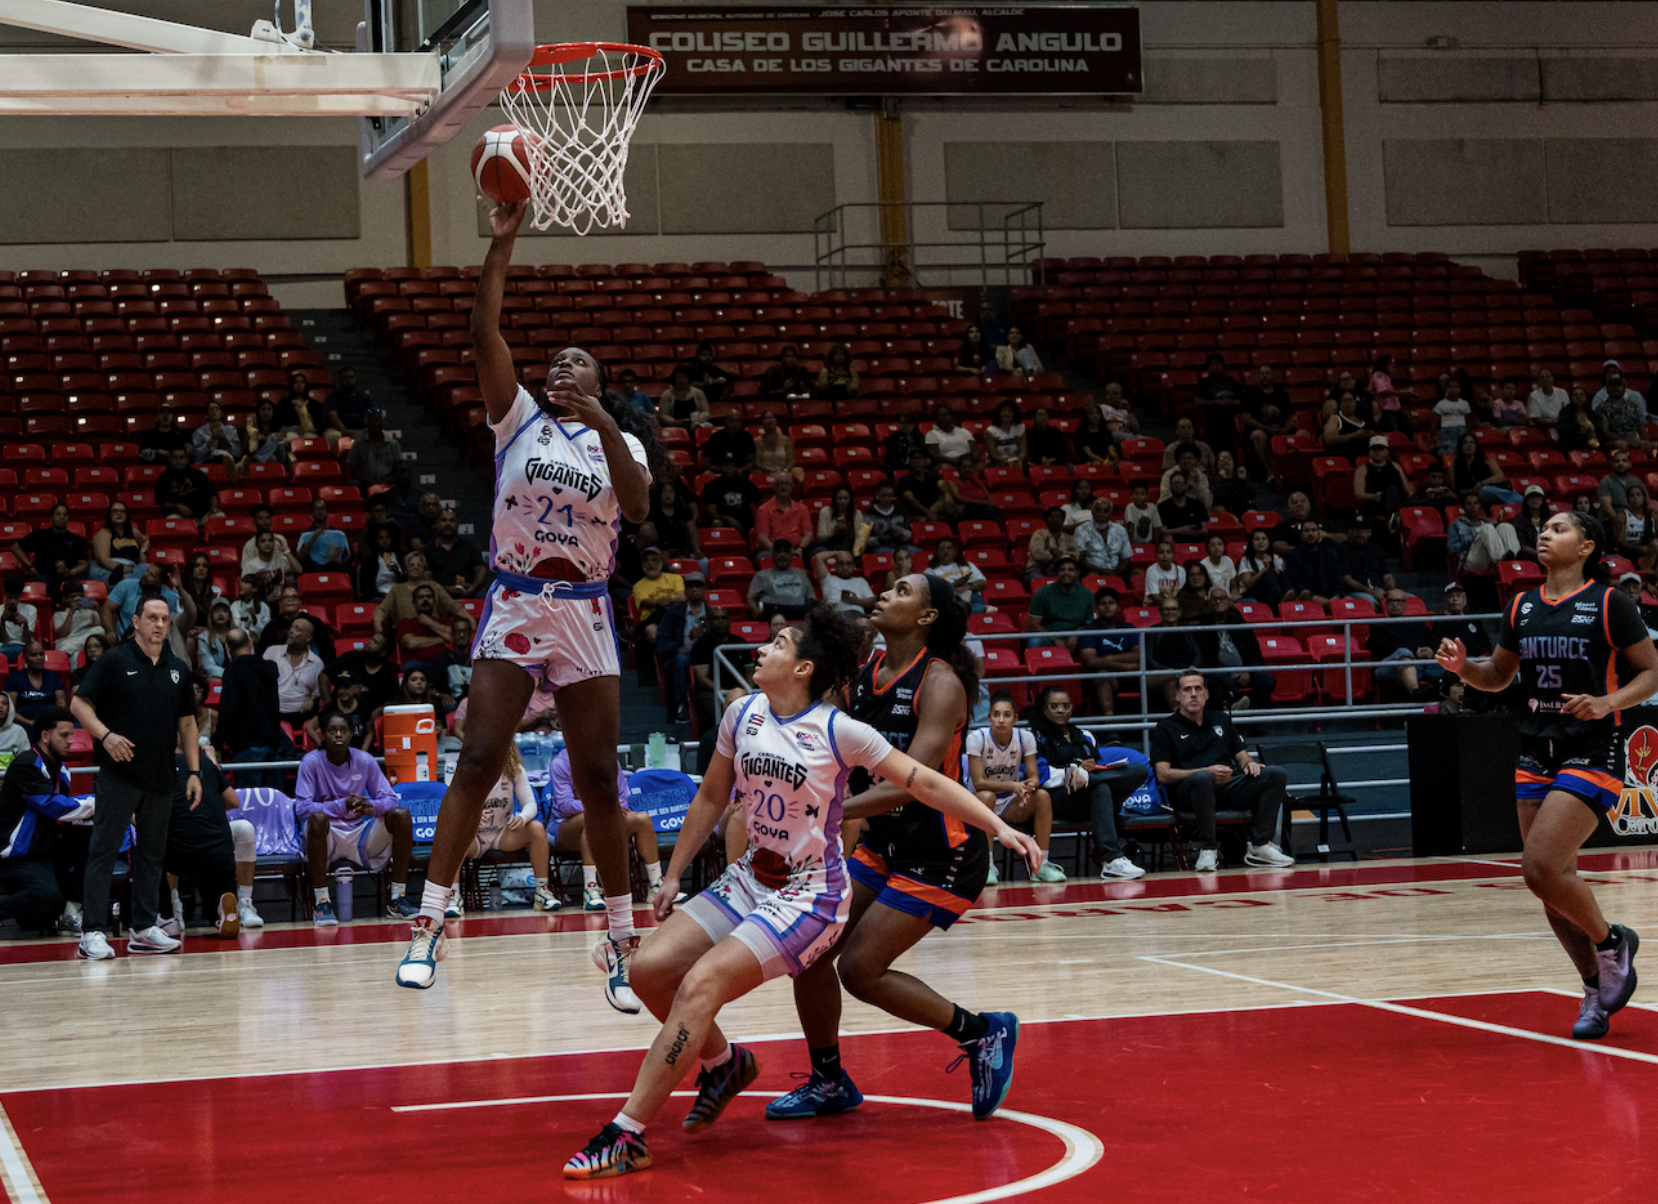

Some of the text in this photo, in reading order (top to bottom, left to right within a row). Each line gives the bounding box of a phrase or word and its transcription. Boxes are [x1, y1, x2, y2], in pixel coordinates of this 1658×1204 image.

[849, 9, 889, 17] CARLOS
[892, 9, 933, 17] APONTE
[982, 8, 1025, 16] ALCALDE
[649, 32, 1123, 52] COLISEO GUILLERMO ANGULO
[687, 58, 1089, 73] CASA DE LOS GIGANTES DE CAROLINA
[525, 457, 603, 503] GIGANTES
[538, 496, 574, 527] 21
[535, 530, 579, 547] GOYA
[1535, 664, 1563, 689] 25
[741, 752, 808, 792] GIGANTES
[754, 789, 786, 822] 20
[1122, 794, 1152, 806] OYA
[660, 815, 687, 829] GOY
[754, 821, 789, 840] GOYA
[1614, 816, 1658, 836] Caro
[415, 827, 437, 839] GO
